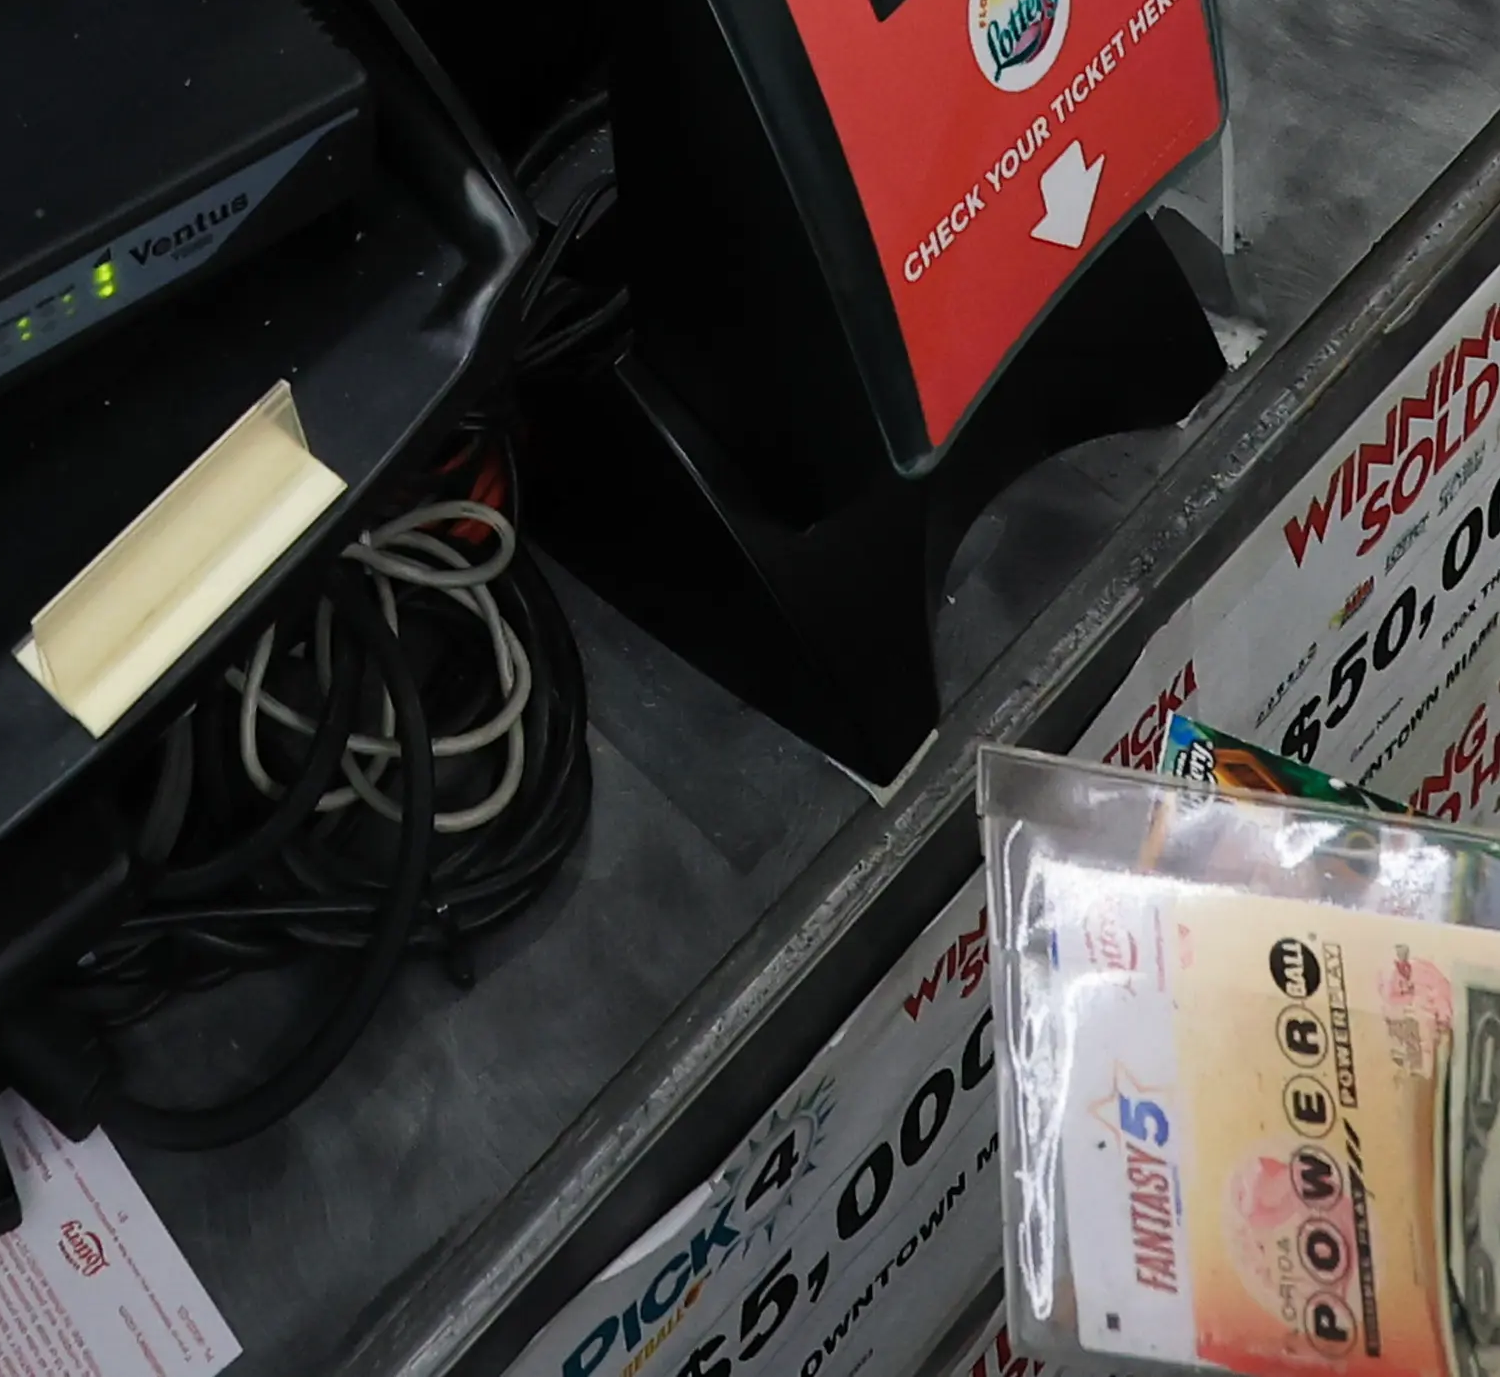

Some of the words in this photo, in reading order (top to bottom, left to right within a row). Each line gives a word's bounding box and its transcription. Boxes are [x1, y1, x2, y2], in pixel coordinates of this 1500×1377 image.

[902, 185, 986, 285] CHECK
[984, 116, 1052, 192] YOUR
[1050, 31, 1127, 127] TICKET
[128, 192, 251, 268] Ventus
[1444, 605, 1500, 687] MIAMI
[1119, 1094, 1171, 1149] 5
[561, 1195, 742, 1377] PICK
[744, 1130, 801, 1213] 4
[1135, 1141, 1179, 1297] FANTASY
